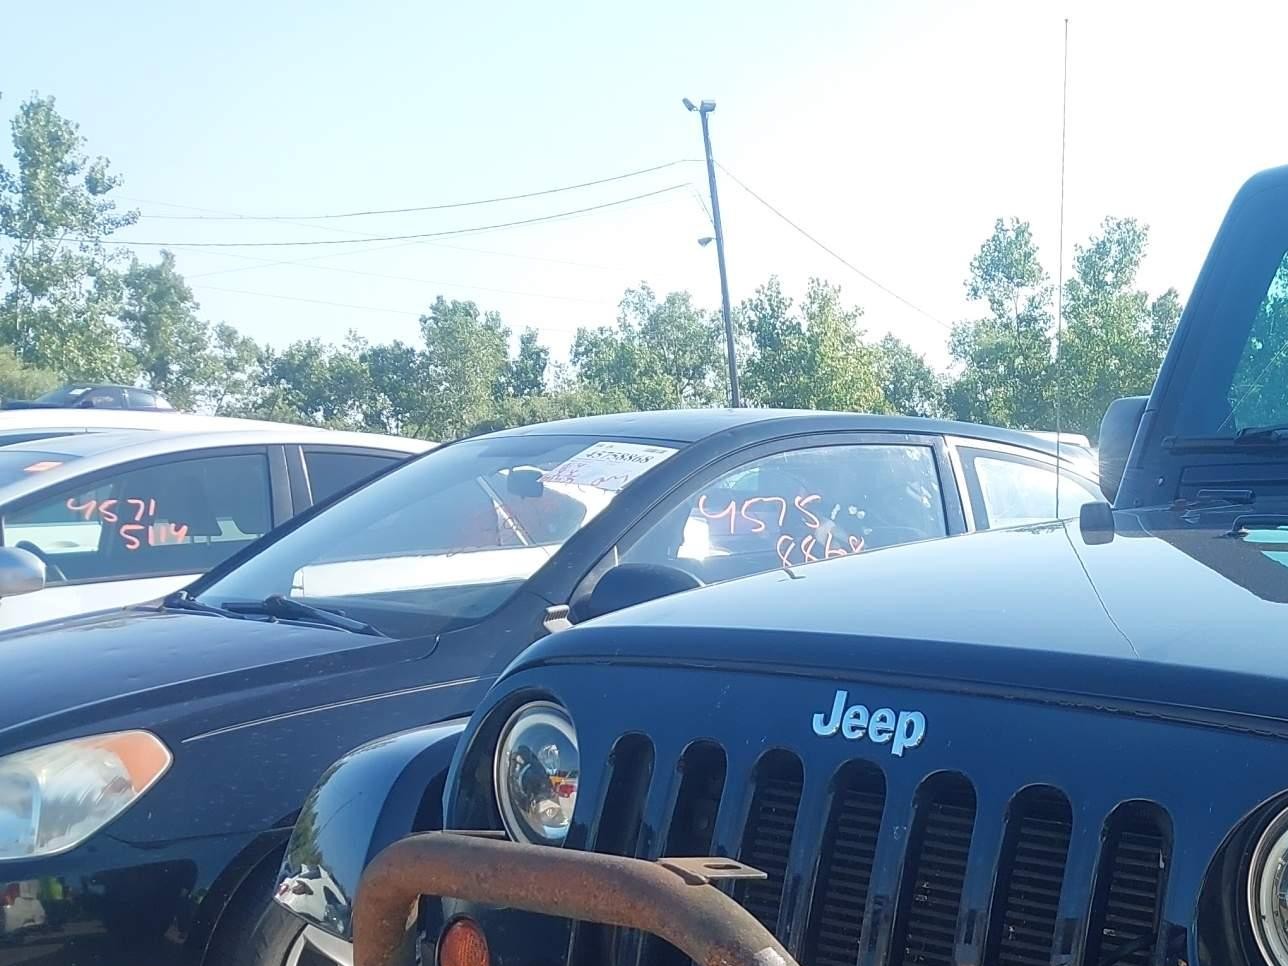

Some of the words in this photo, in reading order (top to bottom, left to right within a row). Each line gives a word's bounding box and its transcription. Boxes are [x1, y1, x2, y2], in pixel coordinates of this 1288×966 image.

[66, 498, 156, 521] 4571
[698, 494, 821, 534] 4575
[119, 522, 188, 550] 5114
[812, 689, 926, 757] Jeep
